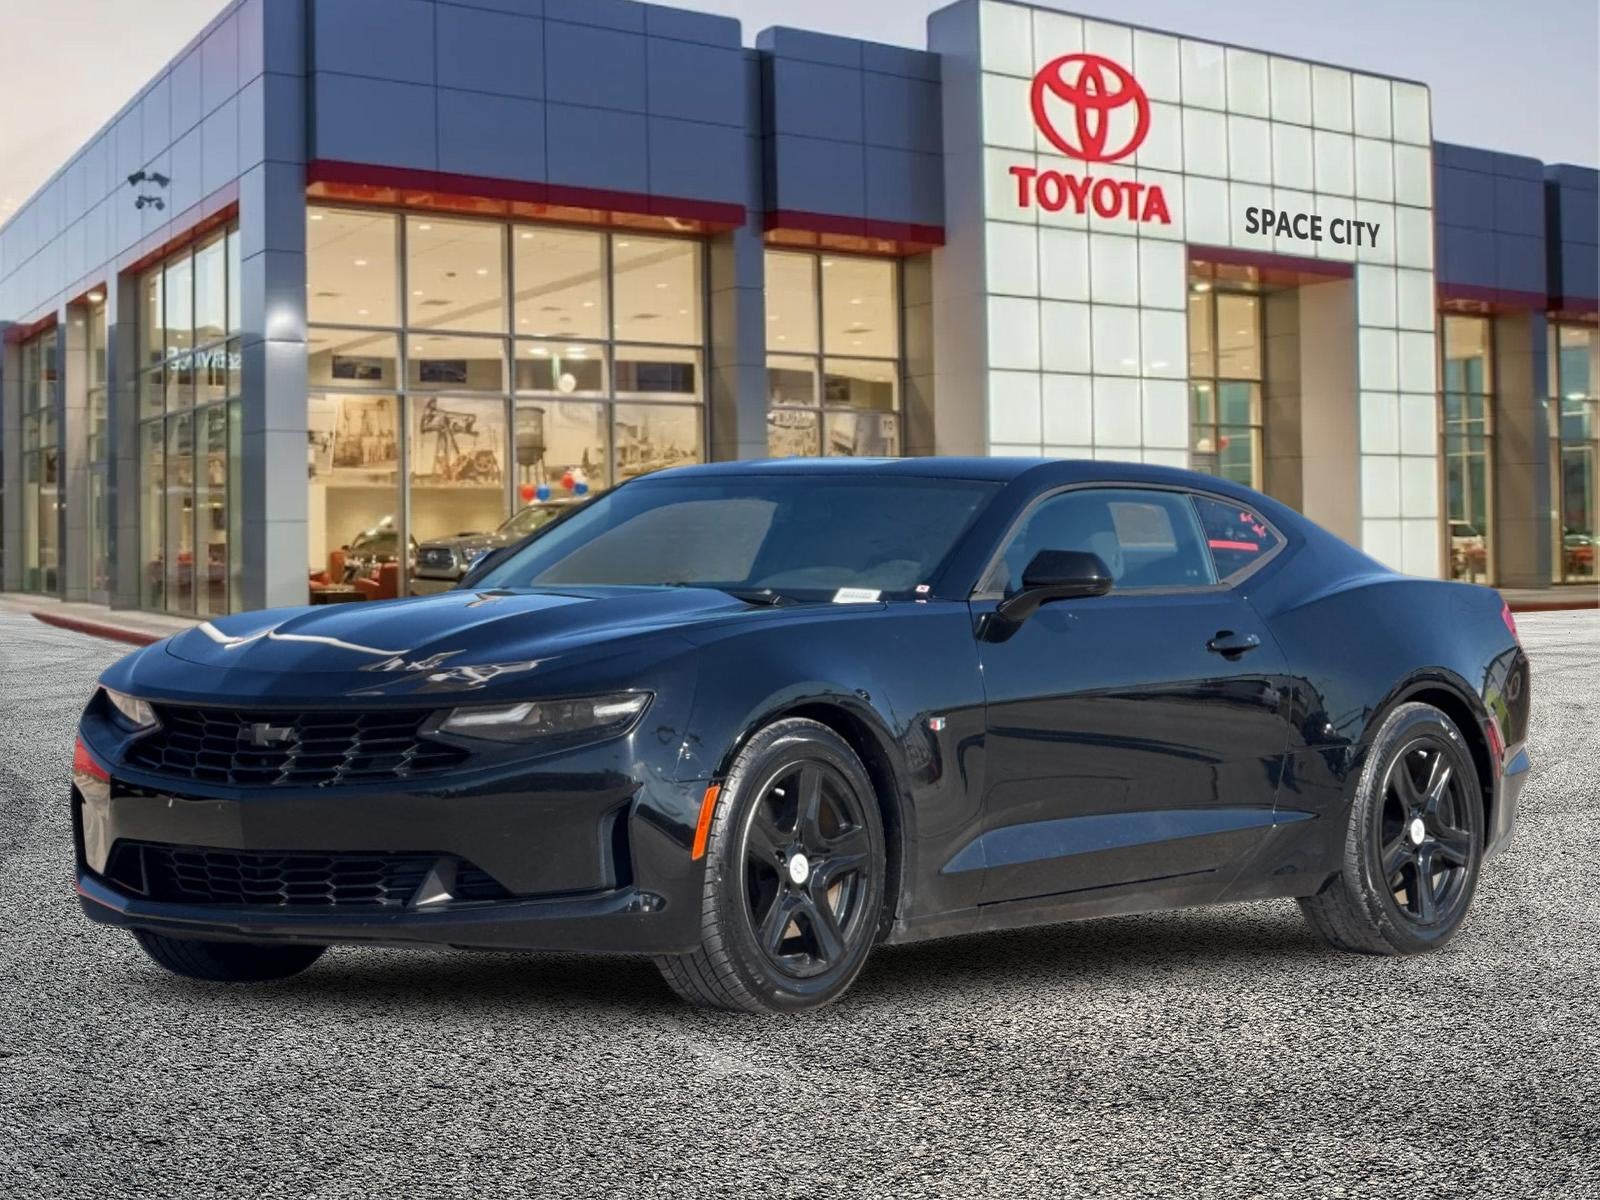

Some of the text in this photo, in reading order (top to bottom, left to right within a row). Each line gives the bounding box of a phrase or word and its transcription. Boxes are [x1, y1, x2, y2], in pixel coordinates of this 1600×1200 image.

[1009, 166, 1171, 224] TOYOTA
[1245, 206, 1380, 248] SPACE CITY
